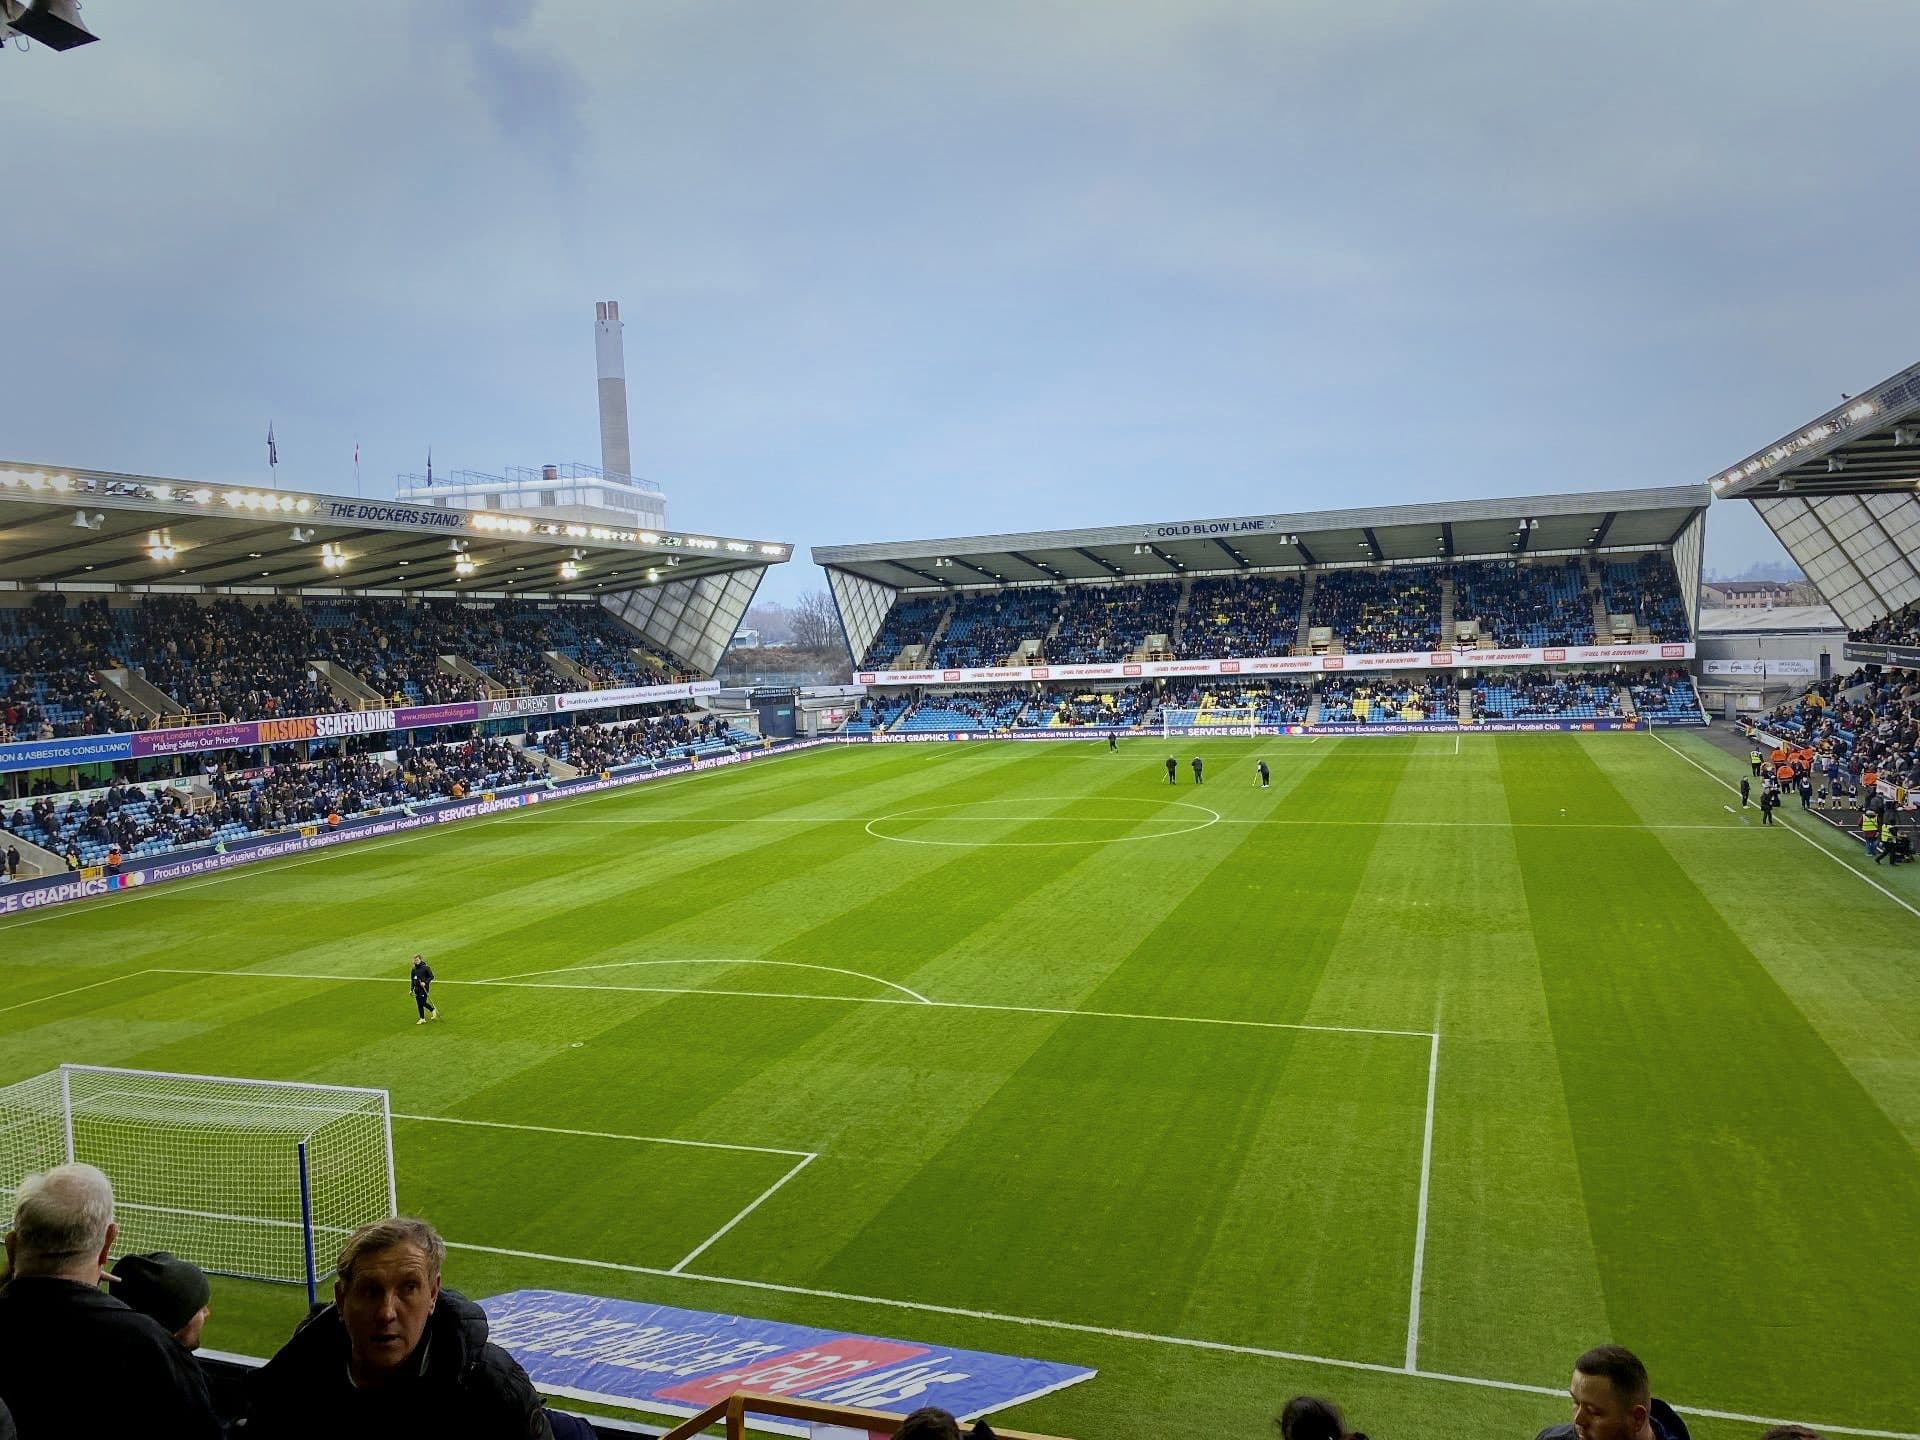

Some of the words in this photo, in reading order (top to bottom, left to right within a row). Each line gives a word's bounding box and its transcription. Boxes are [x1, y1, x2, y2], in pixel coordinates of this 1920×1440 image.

[330, 503, 356, 518] THE
[357, 506, 419, 524] DOCKERS
[420, 512, 460, 527] STAND
[1157, 525, 1190, 537] COLD
[1193, 522, 1230, 534] BLOW
[1232, 520, 1264, 531] LANE
[138, 734, 165, 744] Serving
[166, 730, 192, 741] London
[193, 729, 206, 738] For
[206, 727, 224, 736] Over
[234, 725, 250, 734] Years
[257, 718, 316, 742] MASONS
[315, 710, 396, 736] SCAFFOLDING
[1187, 727, 1228, 736] SERVICE
[1430, 724, 1458, 732] Graphics
[152, 742, 178, 752] Making
[178, 738, 199, 749] Safety
[200, 737, 214, 746] Our
[215, 735, 240, 745] Priority
[871, 733, 906, 743] SERVICE
[906, 733, 949, 742] GRAPHICS
[16, 752, 25, 761] &
[25, 749, 71, 760] ASBESTOS
[72, 742, 131, 756] CONSULTANCY
[693, 758, 716, 771] SERVICE
[716, 752, 741, 766] GRAPHICS
[438, 803, 477, 823] SERVICE
[477, 796, 520, 815] GRAPHICS
[153, 866, 180, 880] Proud
[181, 865, 191, 874] to
[192, 861, 204, 870] be
[204, 859, 220, 869] the
[220, 850, 256, 866] Exclusive
[257, 844, 284, 858] Official
[285, 840, 302, 853] Print
[302, 840, 309, 849] &
[309, 834, 340, 848] Graphics
[340, 829, 364, 841] Partner
[364, 826, 373, 836] of
[396, 818, 420, 829] Football
[421, 815, 435, 825] Club
[21, 878, 108, 908] GRAPHICS
